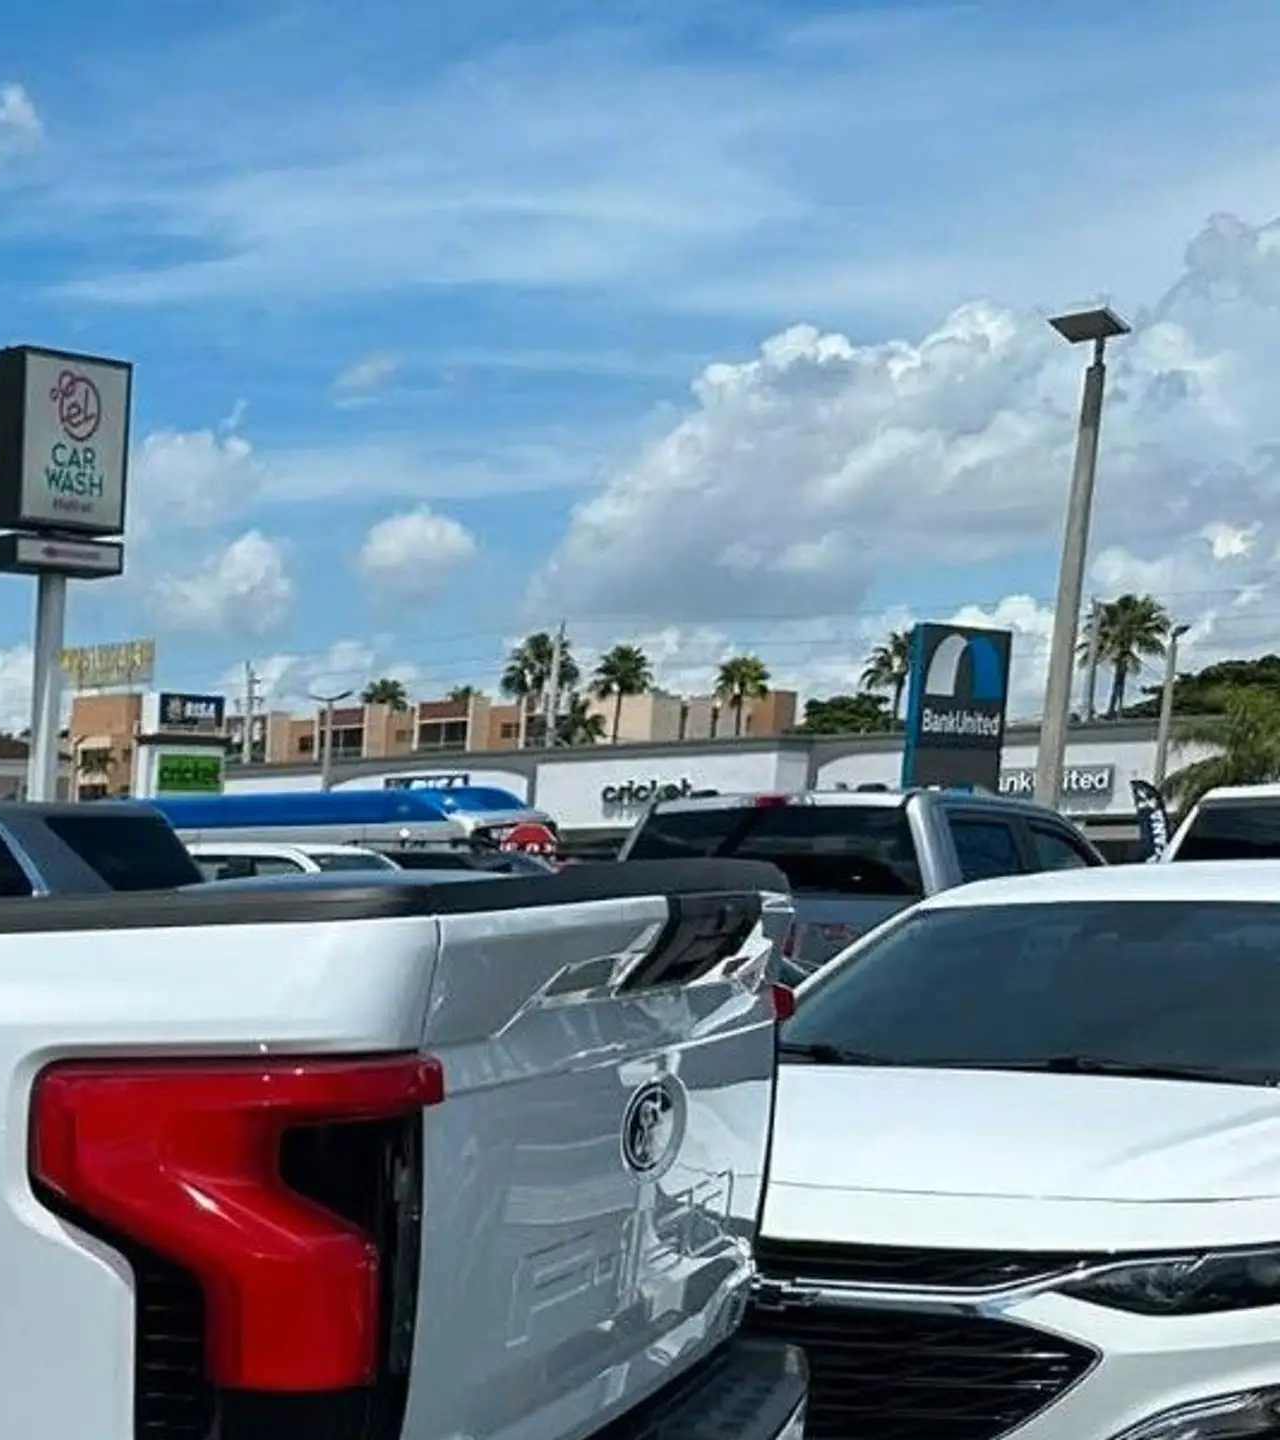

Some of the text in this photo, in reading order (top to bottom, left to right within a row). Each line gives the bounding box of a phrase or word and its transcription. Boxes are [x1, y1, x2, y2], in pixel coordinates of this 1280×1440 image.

[51, 443, 96, 471] CAR
[45, 467, 104, 497] WASH
[922, 708, 1000, 736] BankUnited
